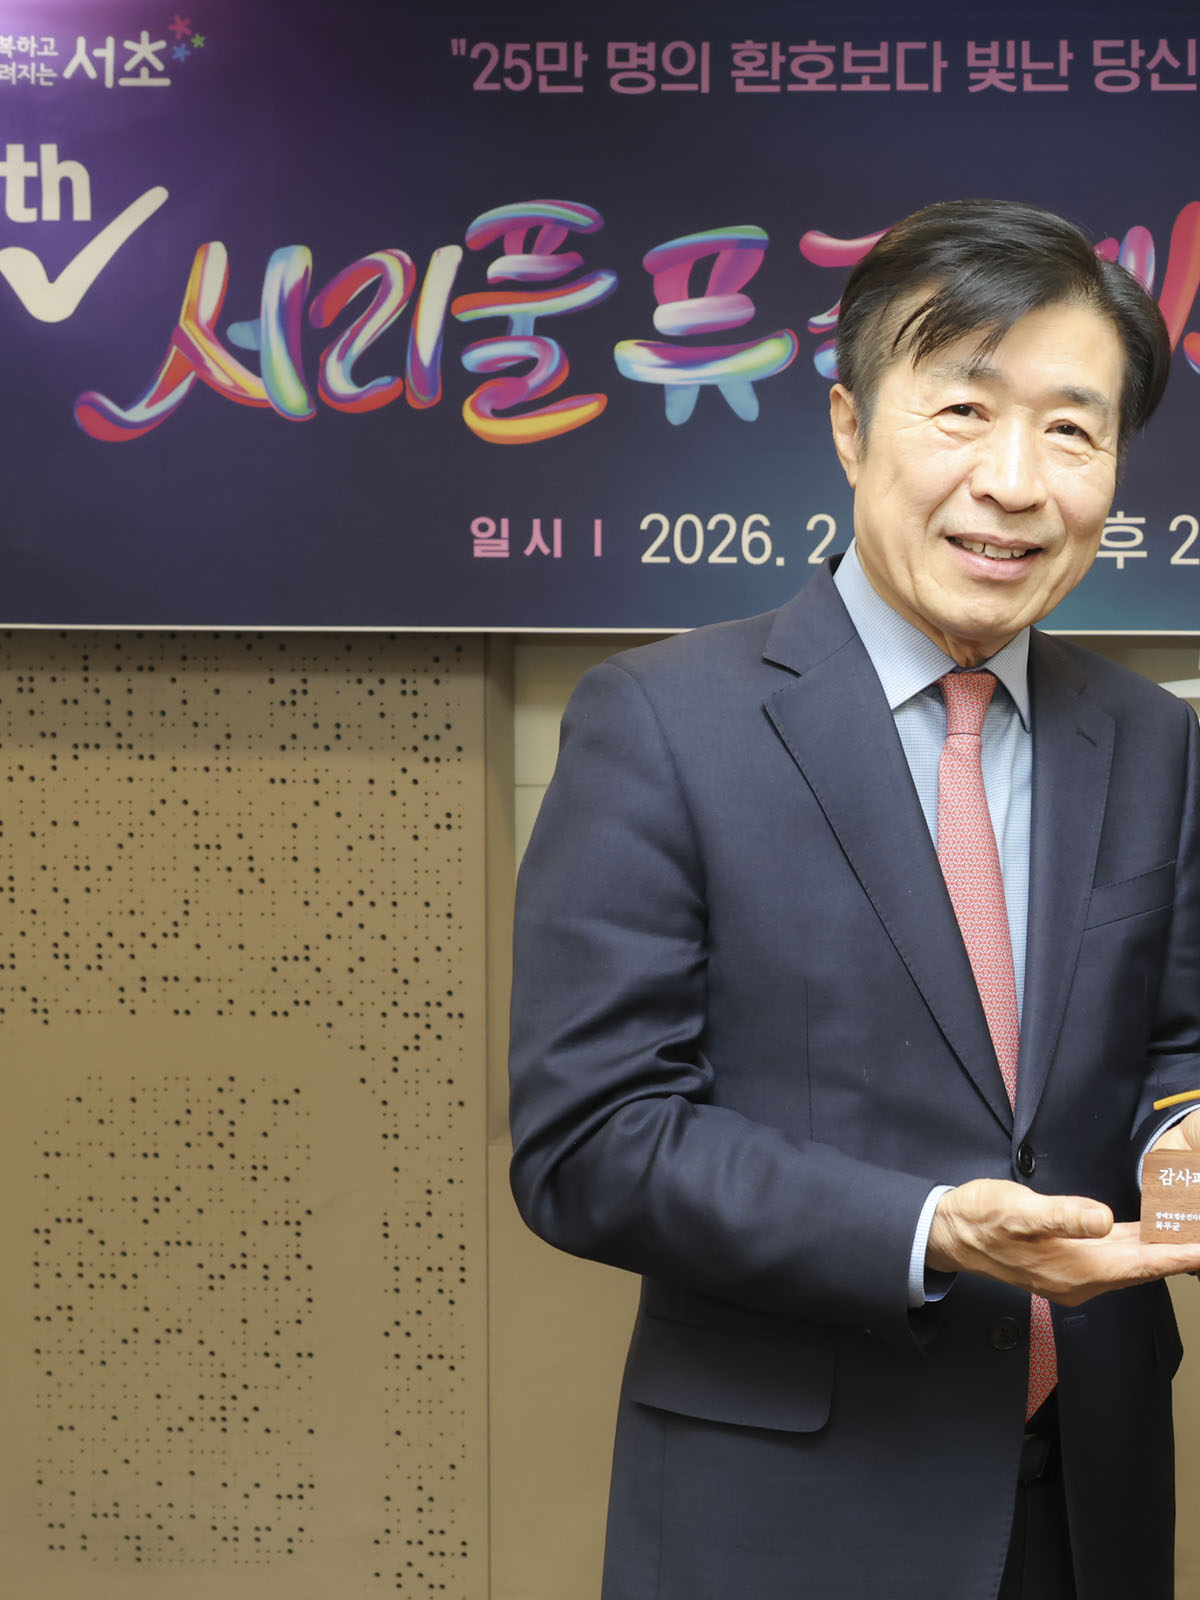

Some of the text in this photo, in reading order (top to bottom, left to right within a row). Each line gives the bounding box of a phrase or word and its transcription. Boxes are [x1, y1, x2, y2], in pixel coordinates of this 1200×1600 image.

[63, 30, 171, 88] 서초
[451, 38, 588, 93] "25만
[607, 41, 710, 94] 명의
[731, 39, 948, 93] 환호보다
[966, 39, 1074, 92] 빛난
[0, 143, 91, 223] th
[638, 512, 785, 567] 2026.
